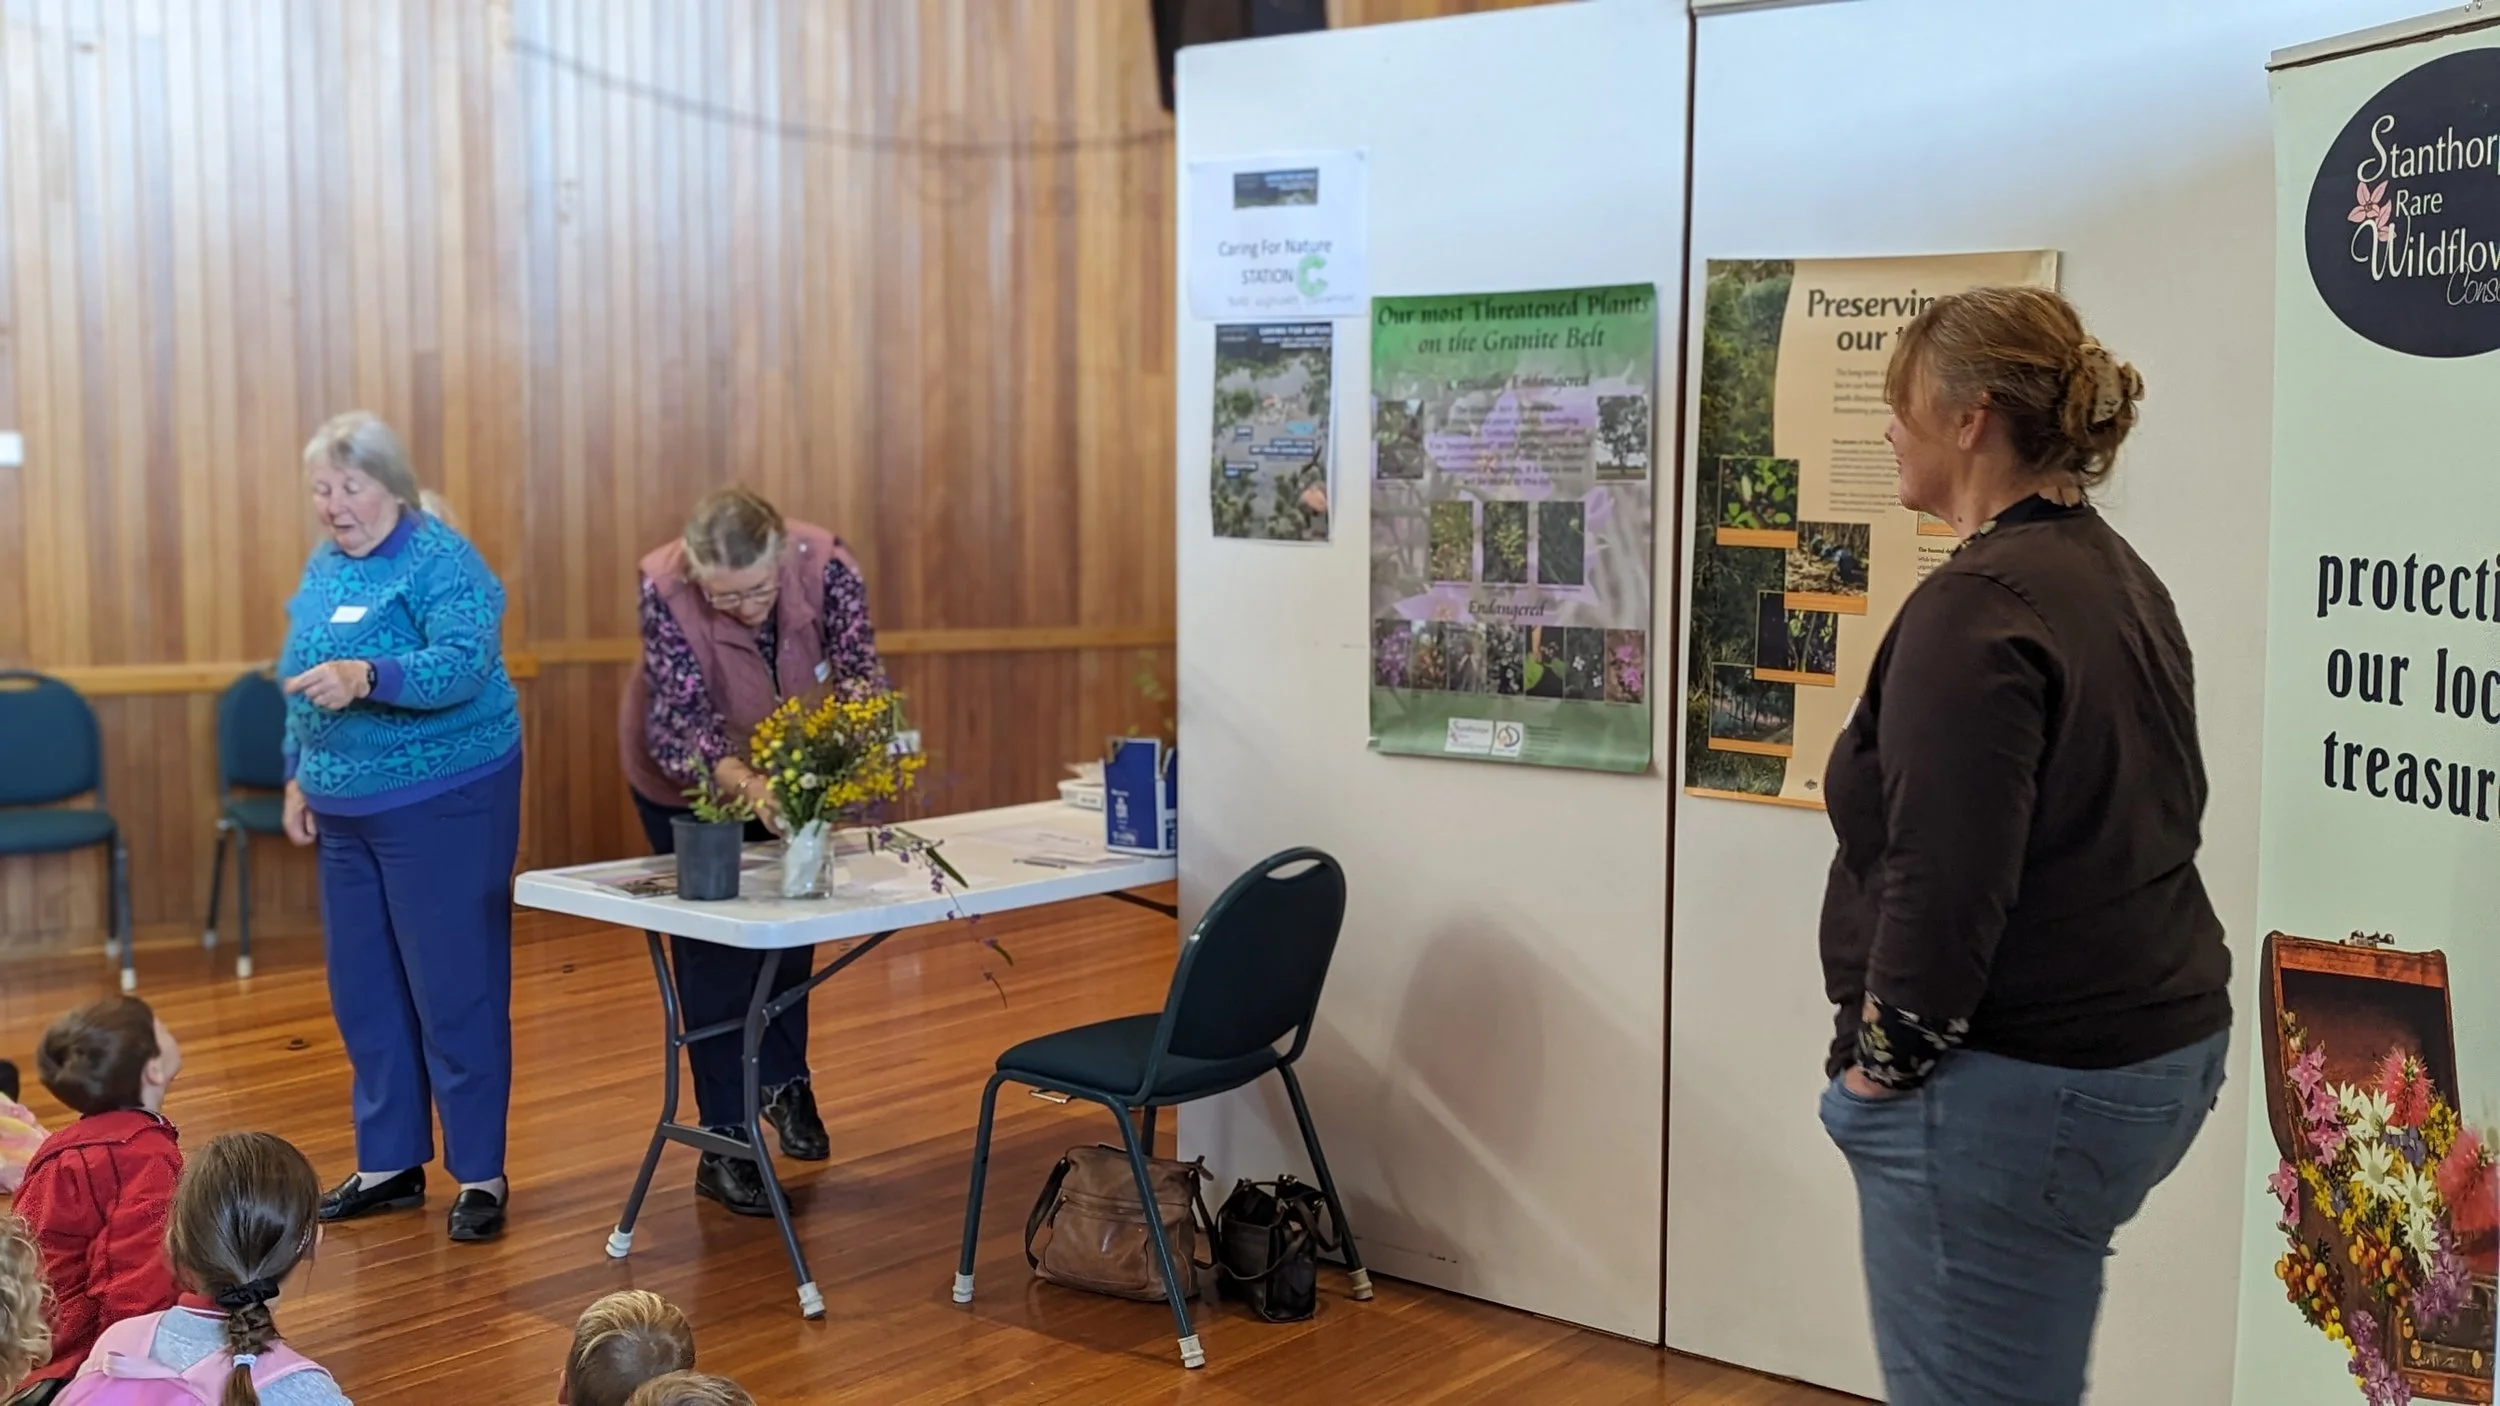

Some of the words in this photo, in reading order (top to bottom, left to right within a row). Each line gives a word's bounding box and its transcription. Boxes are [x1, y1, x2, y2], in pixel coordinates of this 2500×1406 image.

[2356, 113, 2500, 184] Stanthor
[2395, 189, 2443, 218] Rare
[1218, 240, 1259, 259] Caring
[1261, 238, 1281, 256] For
[1284, 238, 1333, 254] Nature
[1241, 268, 1294, 285] STATION
[1296, 254, 1328, 298] C
[1378, 305, 1417, 325] Our
[1420, 304, 1464, 324] most
[1472, 296, 1579, 321] Threatened
[1586, 290, 1650, 316] Plants
[1418, 337, 1441, 354] on
[1448, 327, 1476, 353] the
[1482, 327, 1559, 351] Granite
[1566, 321, 1604, 349] Belt
[1837, 331, 1888, 351] our
[1468, 600, 1545, 620] Endangered
[2327, 648, 2410, 706] our
[2434, 647, 2500, 724] loc
[2323, 730, 2500, 822] treasur
